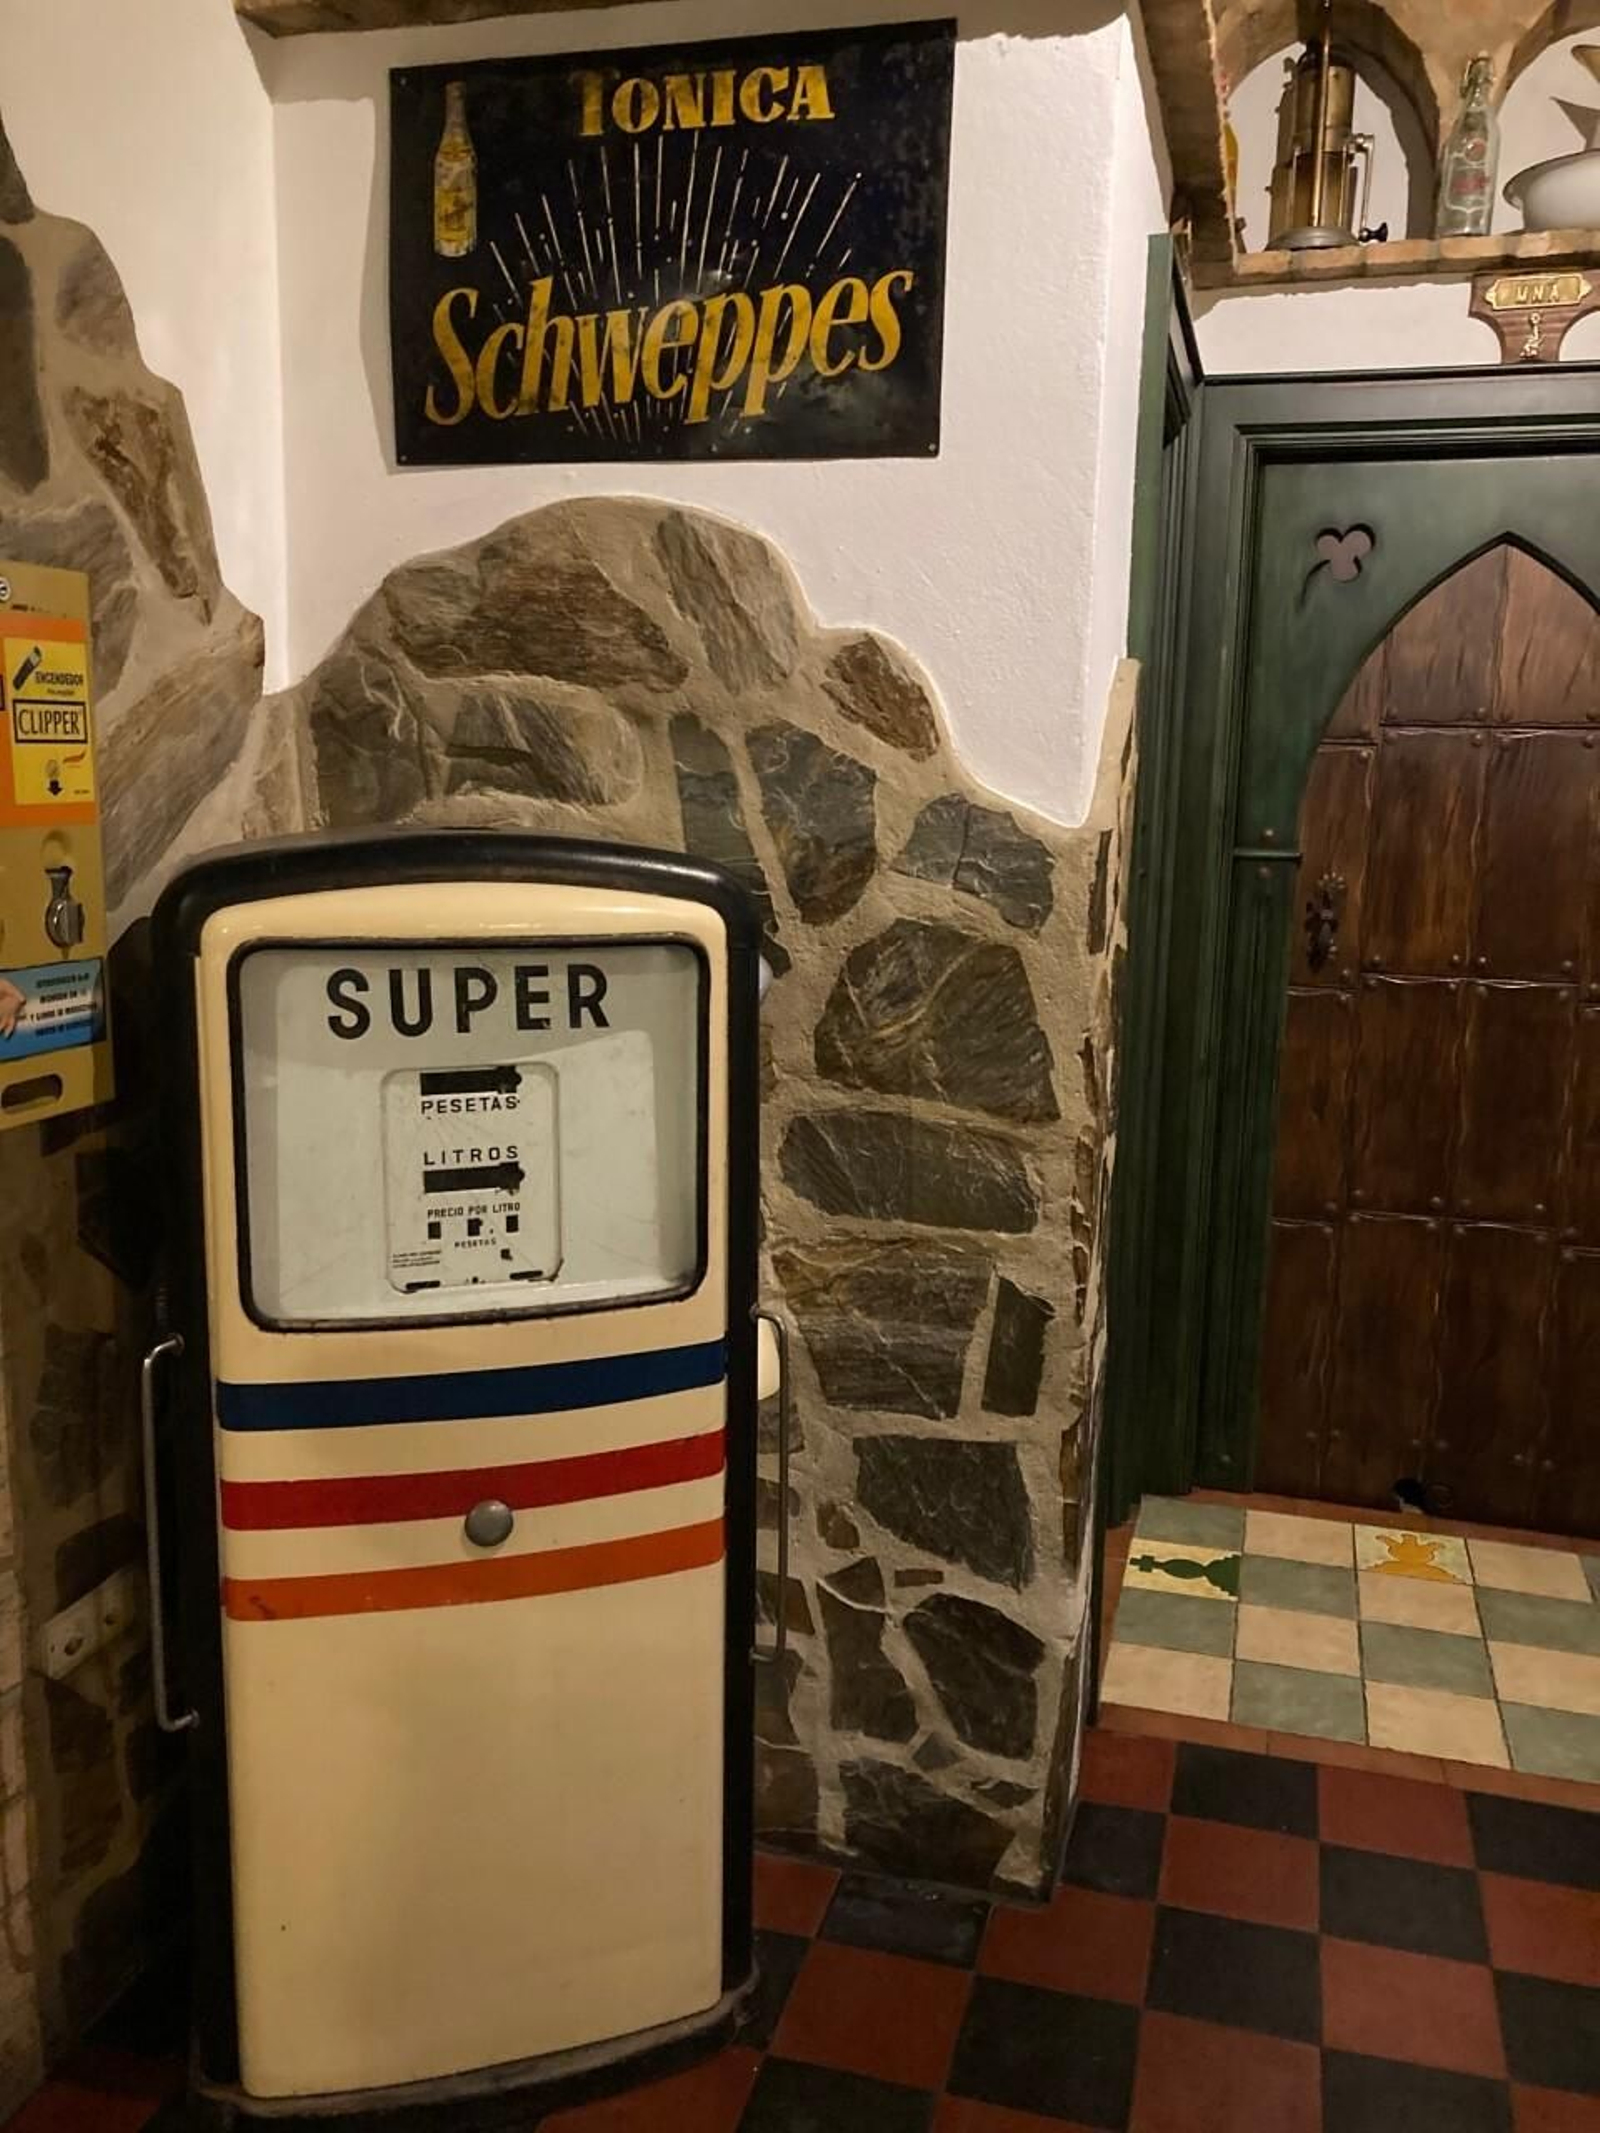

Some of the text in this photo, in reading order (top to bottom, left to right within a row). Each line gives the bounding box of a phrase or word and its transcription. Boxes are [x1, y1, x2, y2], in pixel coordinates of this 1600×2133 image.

[570, 64, 836, 136] TONICA
[424, 270, 914, 426] Schweppes
[19, 709, 80, 735] CLIPPER
[326, 963, 610, 1040] SUPER
[420, 1095, 518, 1115] PESETAS
[423, 1145, 519, 1166] LITROS
[427, 1202, 520, 1219] PRECIO POR LITRO
[454, 1237, 498, 1248] PESETAS
